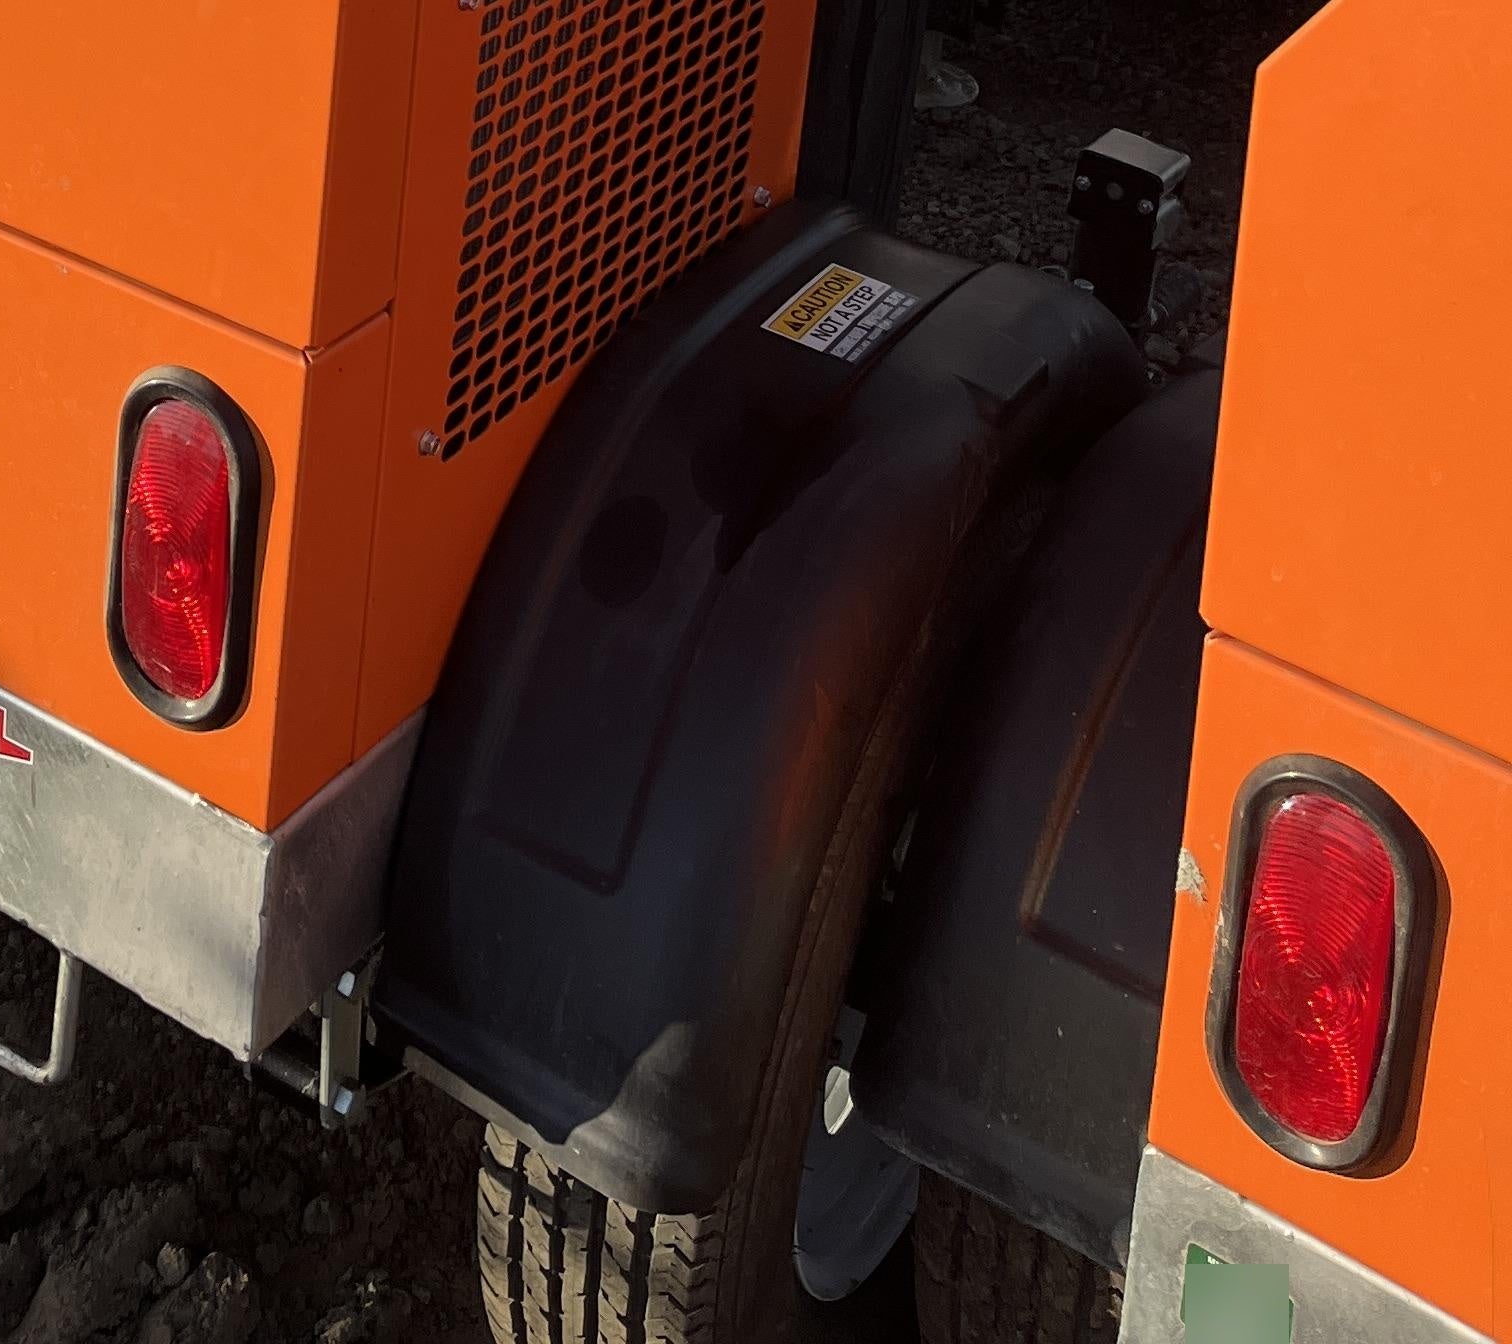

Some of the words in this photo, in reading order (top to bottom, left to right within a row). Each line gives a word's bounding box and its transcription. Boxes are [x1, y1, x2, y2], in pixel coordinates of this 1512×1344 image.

[791, 272, 855, 323] CAUTION
[842, 285, 878, 312] STEP
[838, 310, 853, 321] A
[809, 318, 845, 342] NOT
